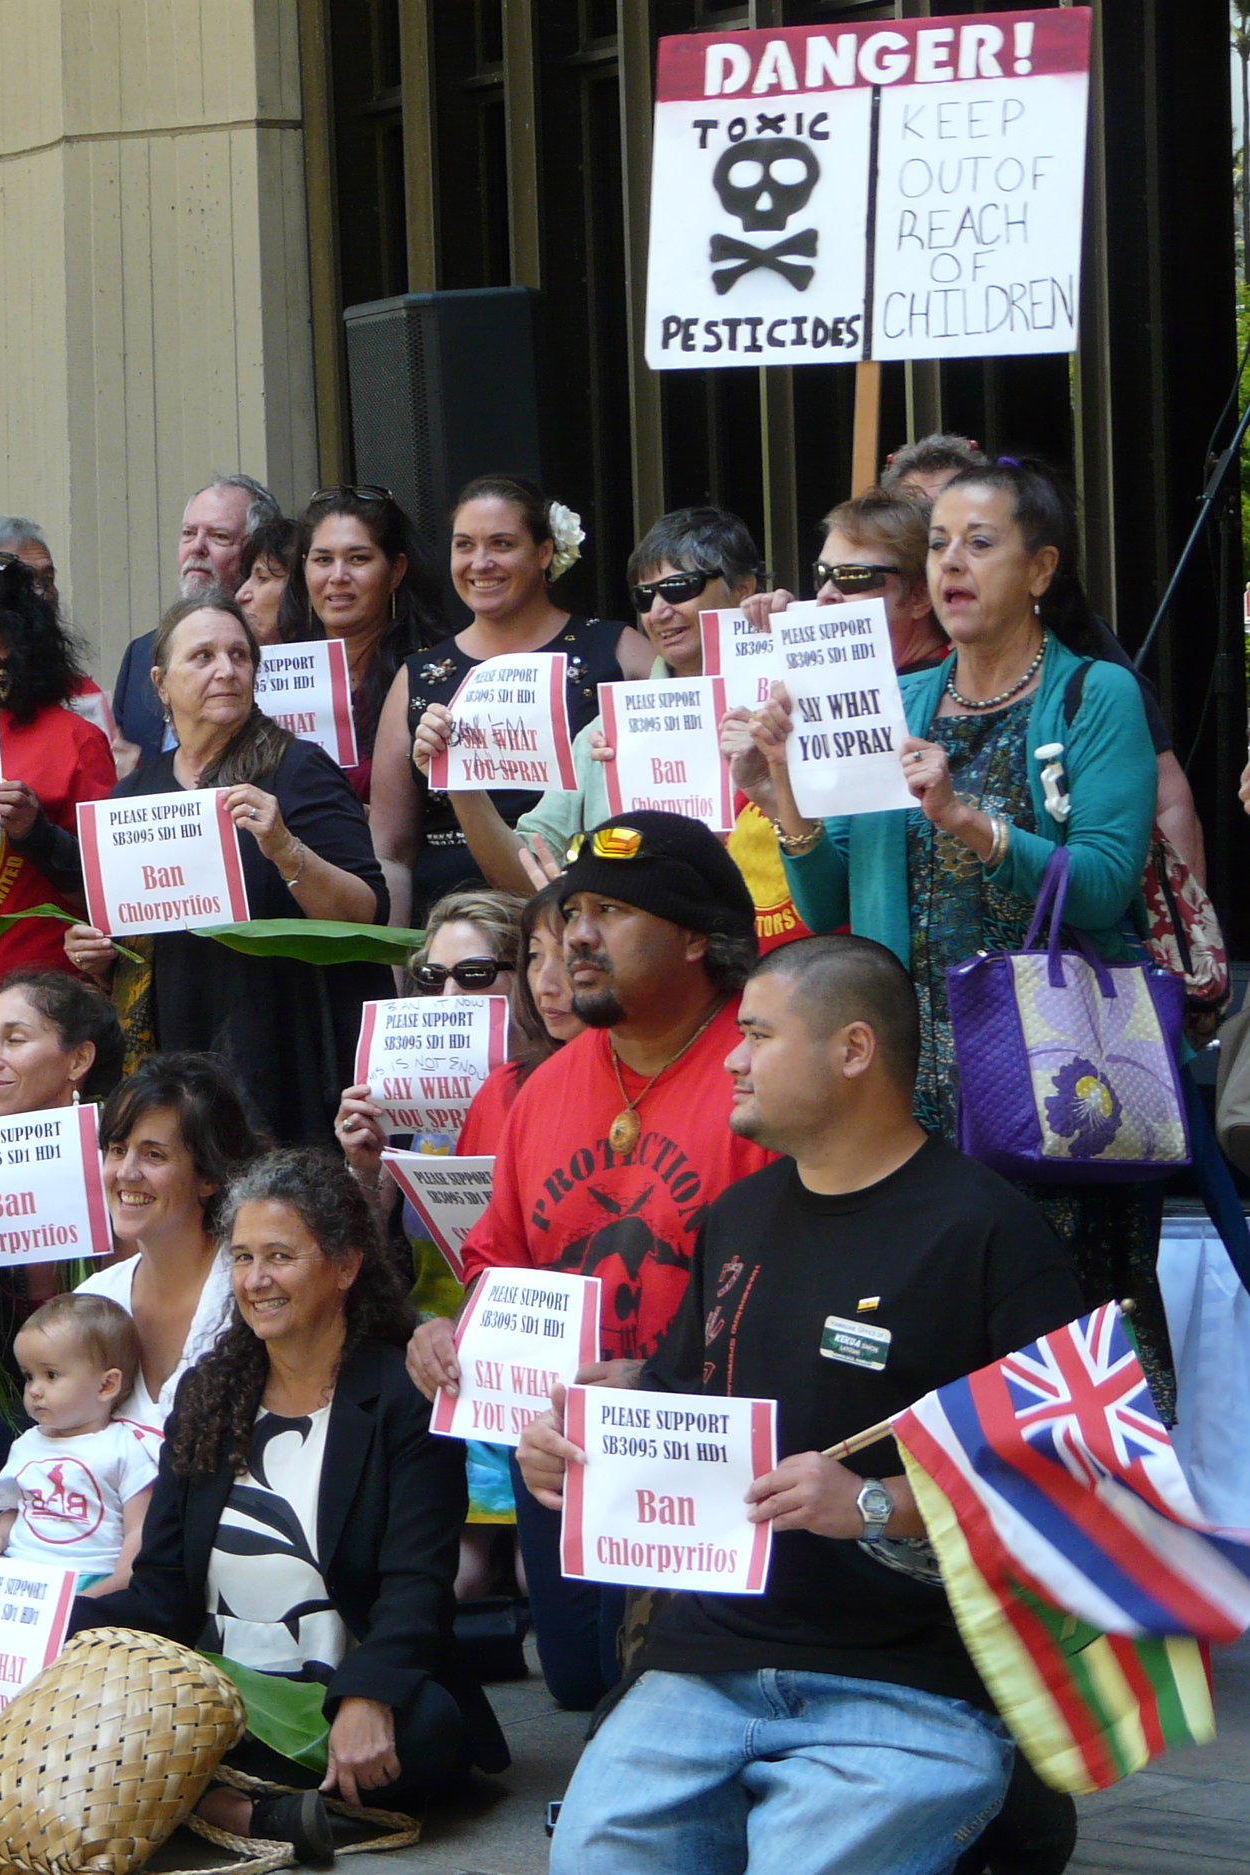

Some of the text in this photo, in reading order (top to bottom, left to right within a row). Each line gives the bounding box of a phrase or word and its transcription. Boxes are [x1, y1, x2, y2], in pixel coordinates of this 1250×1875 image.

[704, 21, 1035, 97] DANGER!
[693, 111, 830, 149] TOXIC
[901, 98, 1025, 140] KEEP
[898, 202, 1028, 252] REACH
[931, 249, 996, 284] OF
[883, 275, 1075, 339] CHILDREN
[661, 314, 861, 353] PESTICIDES
[781, 618, 872, 646] PLEASE SUPPORT
[735, 640, 774, 656] SB3095
[786, 642, 876, 670] SB3095 SD1 HD1
[264, 656, 315, 673] SUPPORT
[497, 669, 539, 683] SUPPORT
[270, 678, 289, 691] SD1
[294, 675, 315, 690] HD1
[497, 689, 535, 704] SD1 HD1
[625, 691, 701, 710] PLEASE SUPPORT
[799, 688, 881, 723] SAY WHAT
[629, 715, 702, 733] SB3095 SD1 HD1
[461, 728, 538, 751] SAY WHAT
[798, 726, 894, 762] YOU SPRAY
[462, 759, 549, 782] YOU SPRAY
[651, 757, 687, 785] Ban
[110, 802, 201, 826] PLEASE SUPPORT
[113, 823, 203, 846] SB3095 SD1 HD1
[141, 865, 185, 890] Ban
[118, 894, 221, 923] Chlorpyrifos
[455, 997, 485, 1009] NOW
[386, 1012, 474, 1029] PLEASE SUPPORT
[384, 1034, 471, 1051] SB3095 SD1 HD1
[415, 1055, 447, 1070] NOT
[383, 1076, 472, 1100] SAY WHAT
[384, 1108, 423, 1128] YOU
[0, 1121, 62, 1144] SUPPORT
[7, 1148, 30, 1165] SD1
[36, 1144, 62, 1161] HD1
[462, 1191, 485, 1204] SD1
[488, 1285, 570, 1312] PLEASE SUPPORT
[480, 1310, 565, 1338] SB3095 SD1 HD1
[475, 1360, 504, 1391] SAY
[472, 1400, 505, 1432] YOU
[602, 1405, 730, 1434] PLEASE SUPPORT
[603, 1435, 728, 1463] SB3095 SD1 HD1
[636, 1489, 696, 1527] Ban
[597, 1536, 738, 1574] Chlorpyrifos
